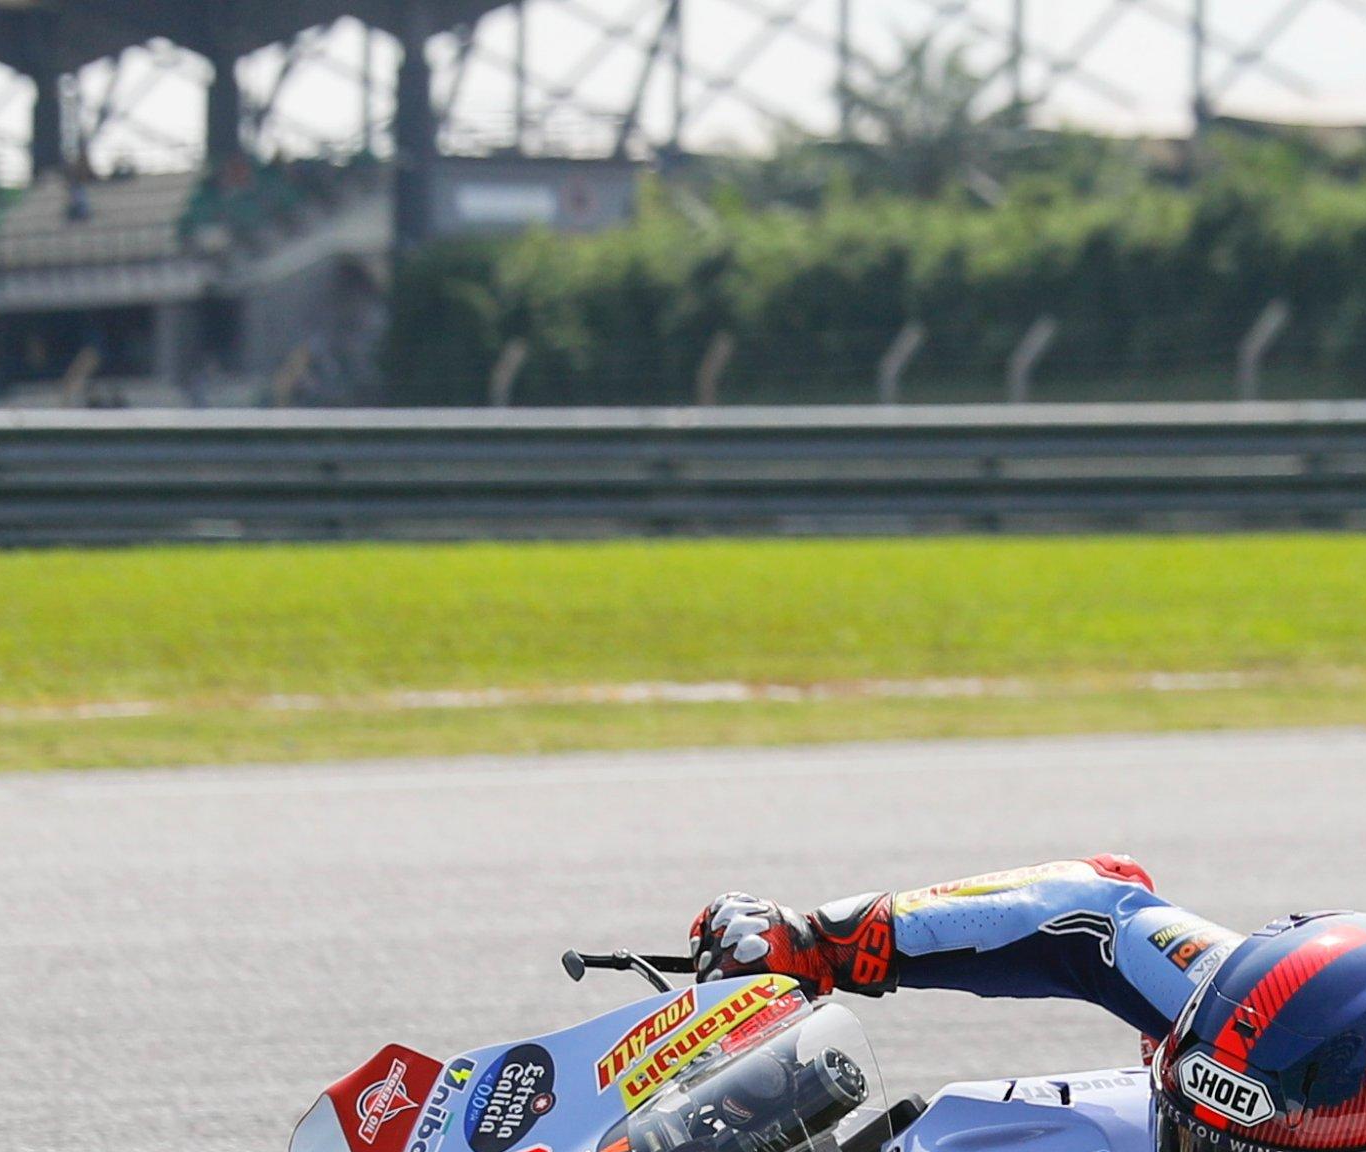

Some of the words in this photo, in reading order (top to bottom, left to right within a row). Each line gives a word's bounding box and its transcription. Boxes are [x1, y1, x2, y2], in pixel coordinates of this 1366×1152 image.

[605, 995, 694, 1087] YOU-ALL
[625, 977, 778, 1097] Antangin
[374, 1064, 404, 1118] FEDERAL
[479, 1063, 524, 1134] Galicia
[496, 1062, 545, 1140] Estrella
[1187, 1062, 1260, 1117] SHOEI
[363, 1114, 380, 1137] OIL
[1187, 1118, 1222, 1145] YOU
